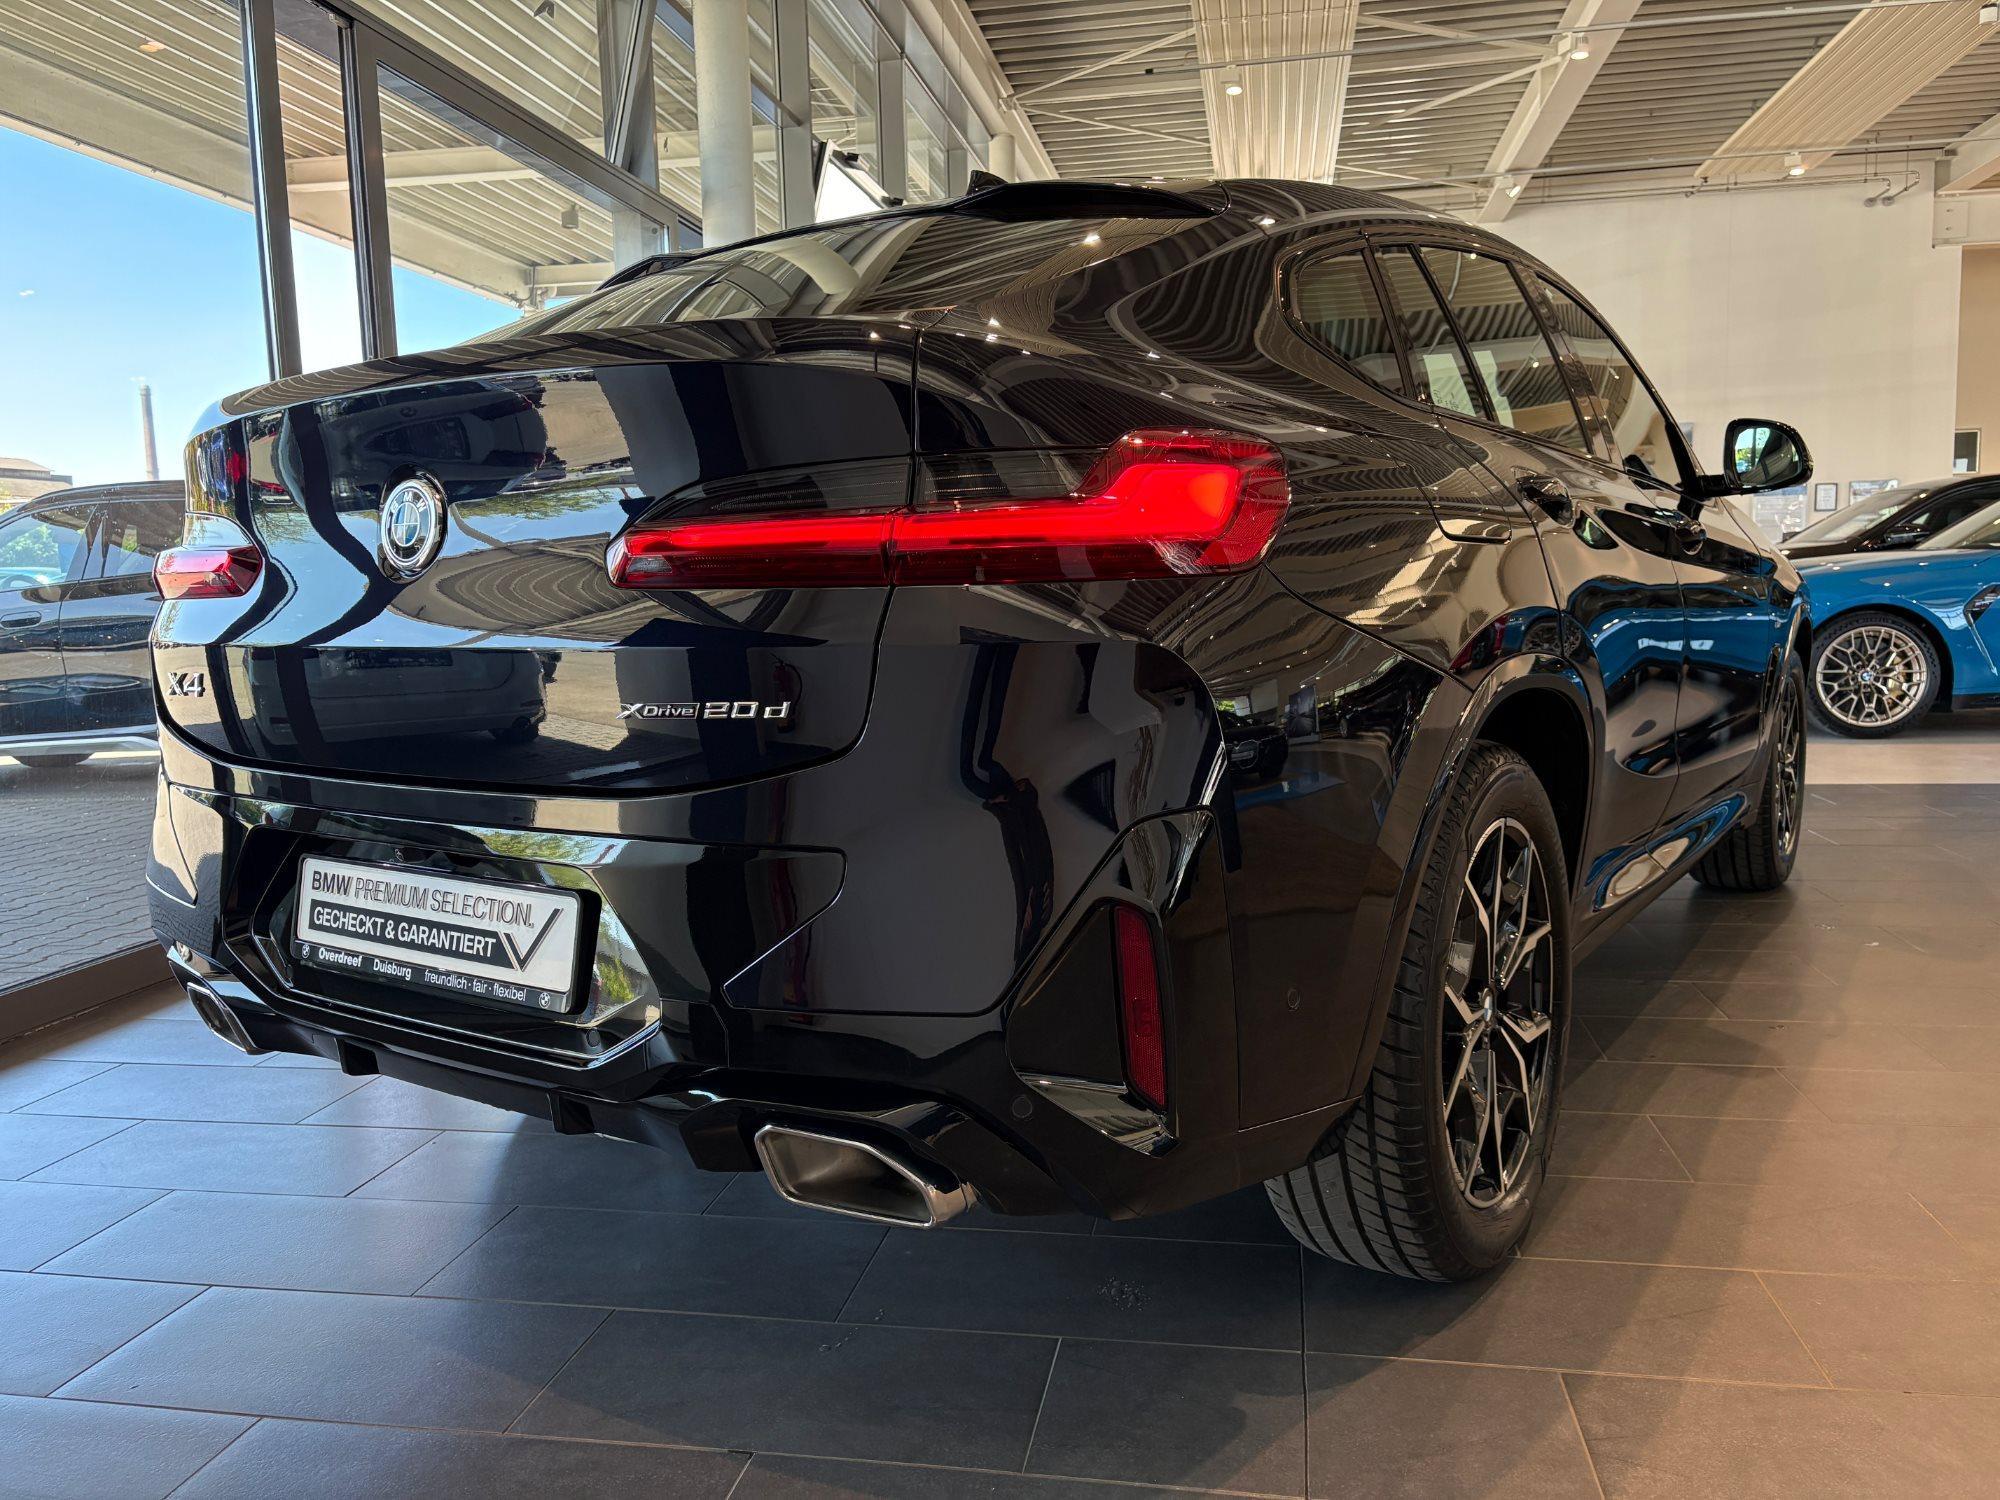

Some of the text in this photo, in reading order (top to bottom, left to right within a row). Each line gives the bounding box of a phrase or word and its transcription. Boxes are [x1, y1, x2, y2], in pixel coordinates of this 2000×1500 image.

[390, 491, 427, 513] BMW
[167, 672, 205, 697] X4
[311, 870, 353, 895] BMW
[355, 878, 429, 910] PREMIUM
[314, 906, 496, 958] GECHECKT & GARANTIERT
[318, 947, 362, 968] Overdreef
[373, 959, 412, 981] Duisburg
[472, 980, 487, 994] fair
[493, 982, 526, 1002] flexibel
